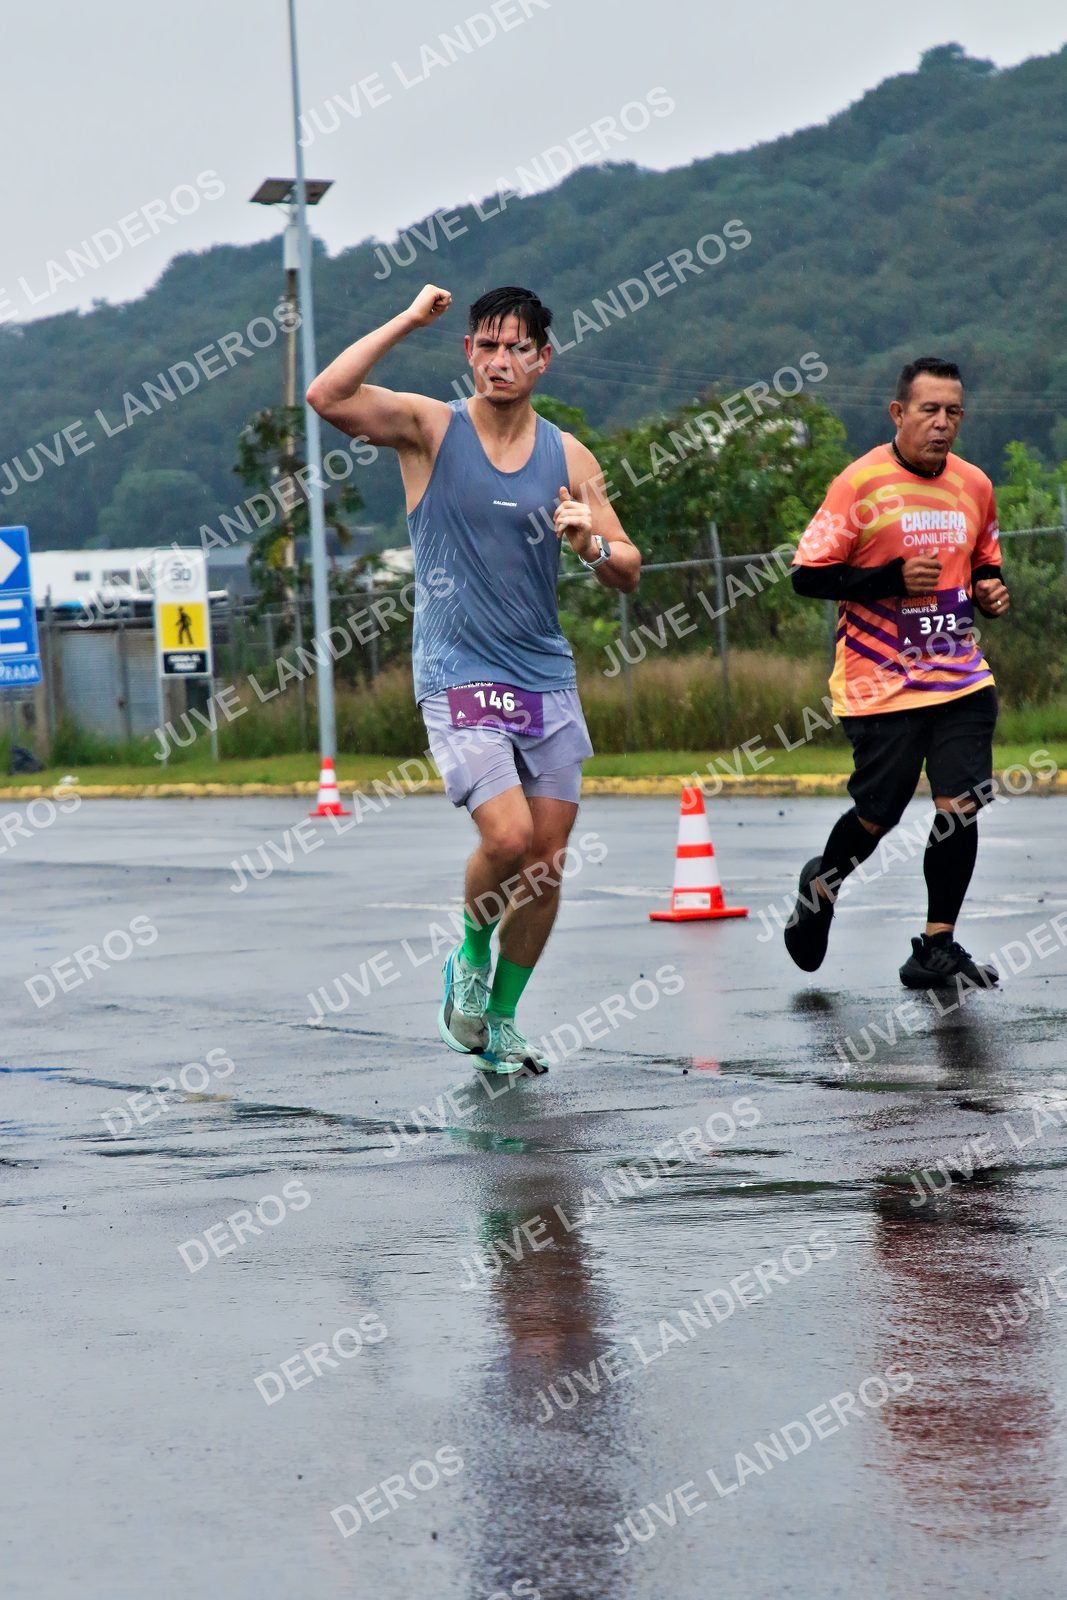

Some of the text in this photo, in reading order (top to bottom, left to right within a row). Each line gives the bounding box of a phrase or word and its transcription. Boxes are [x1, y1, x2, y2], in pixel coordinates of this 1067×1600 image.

[901, 511, 967, 532] CARRERA
[903, 532, 954, 546] OMNILIFE
[919, 613, 956, 634] 373
[474, 690, 515, 712] 146
